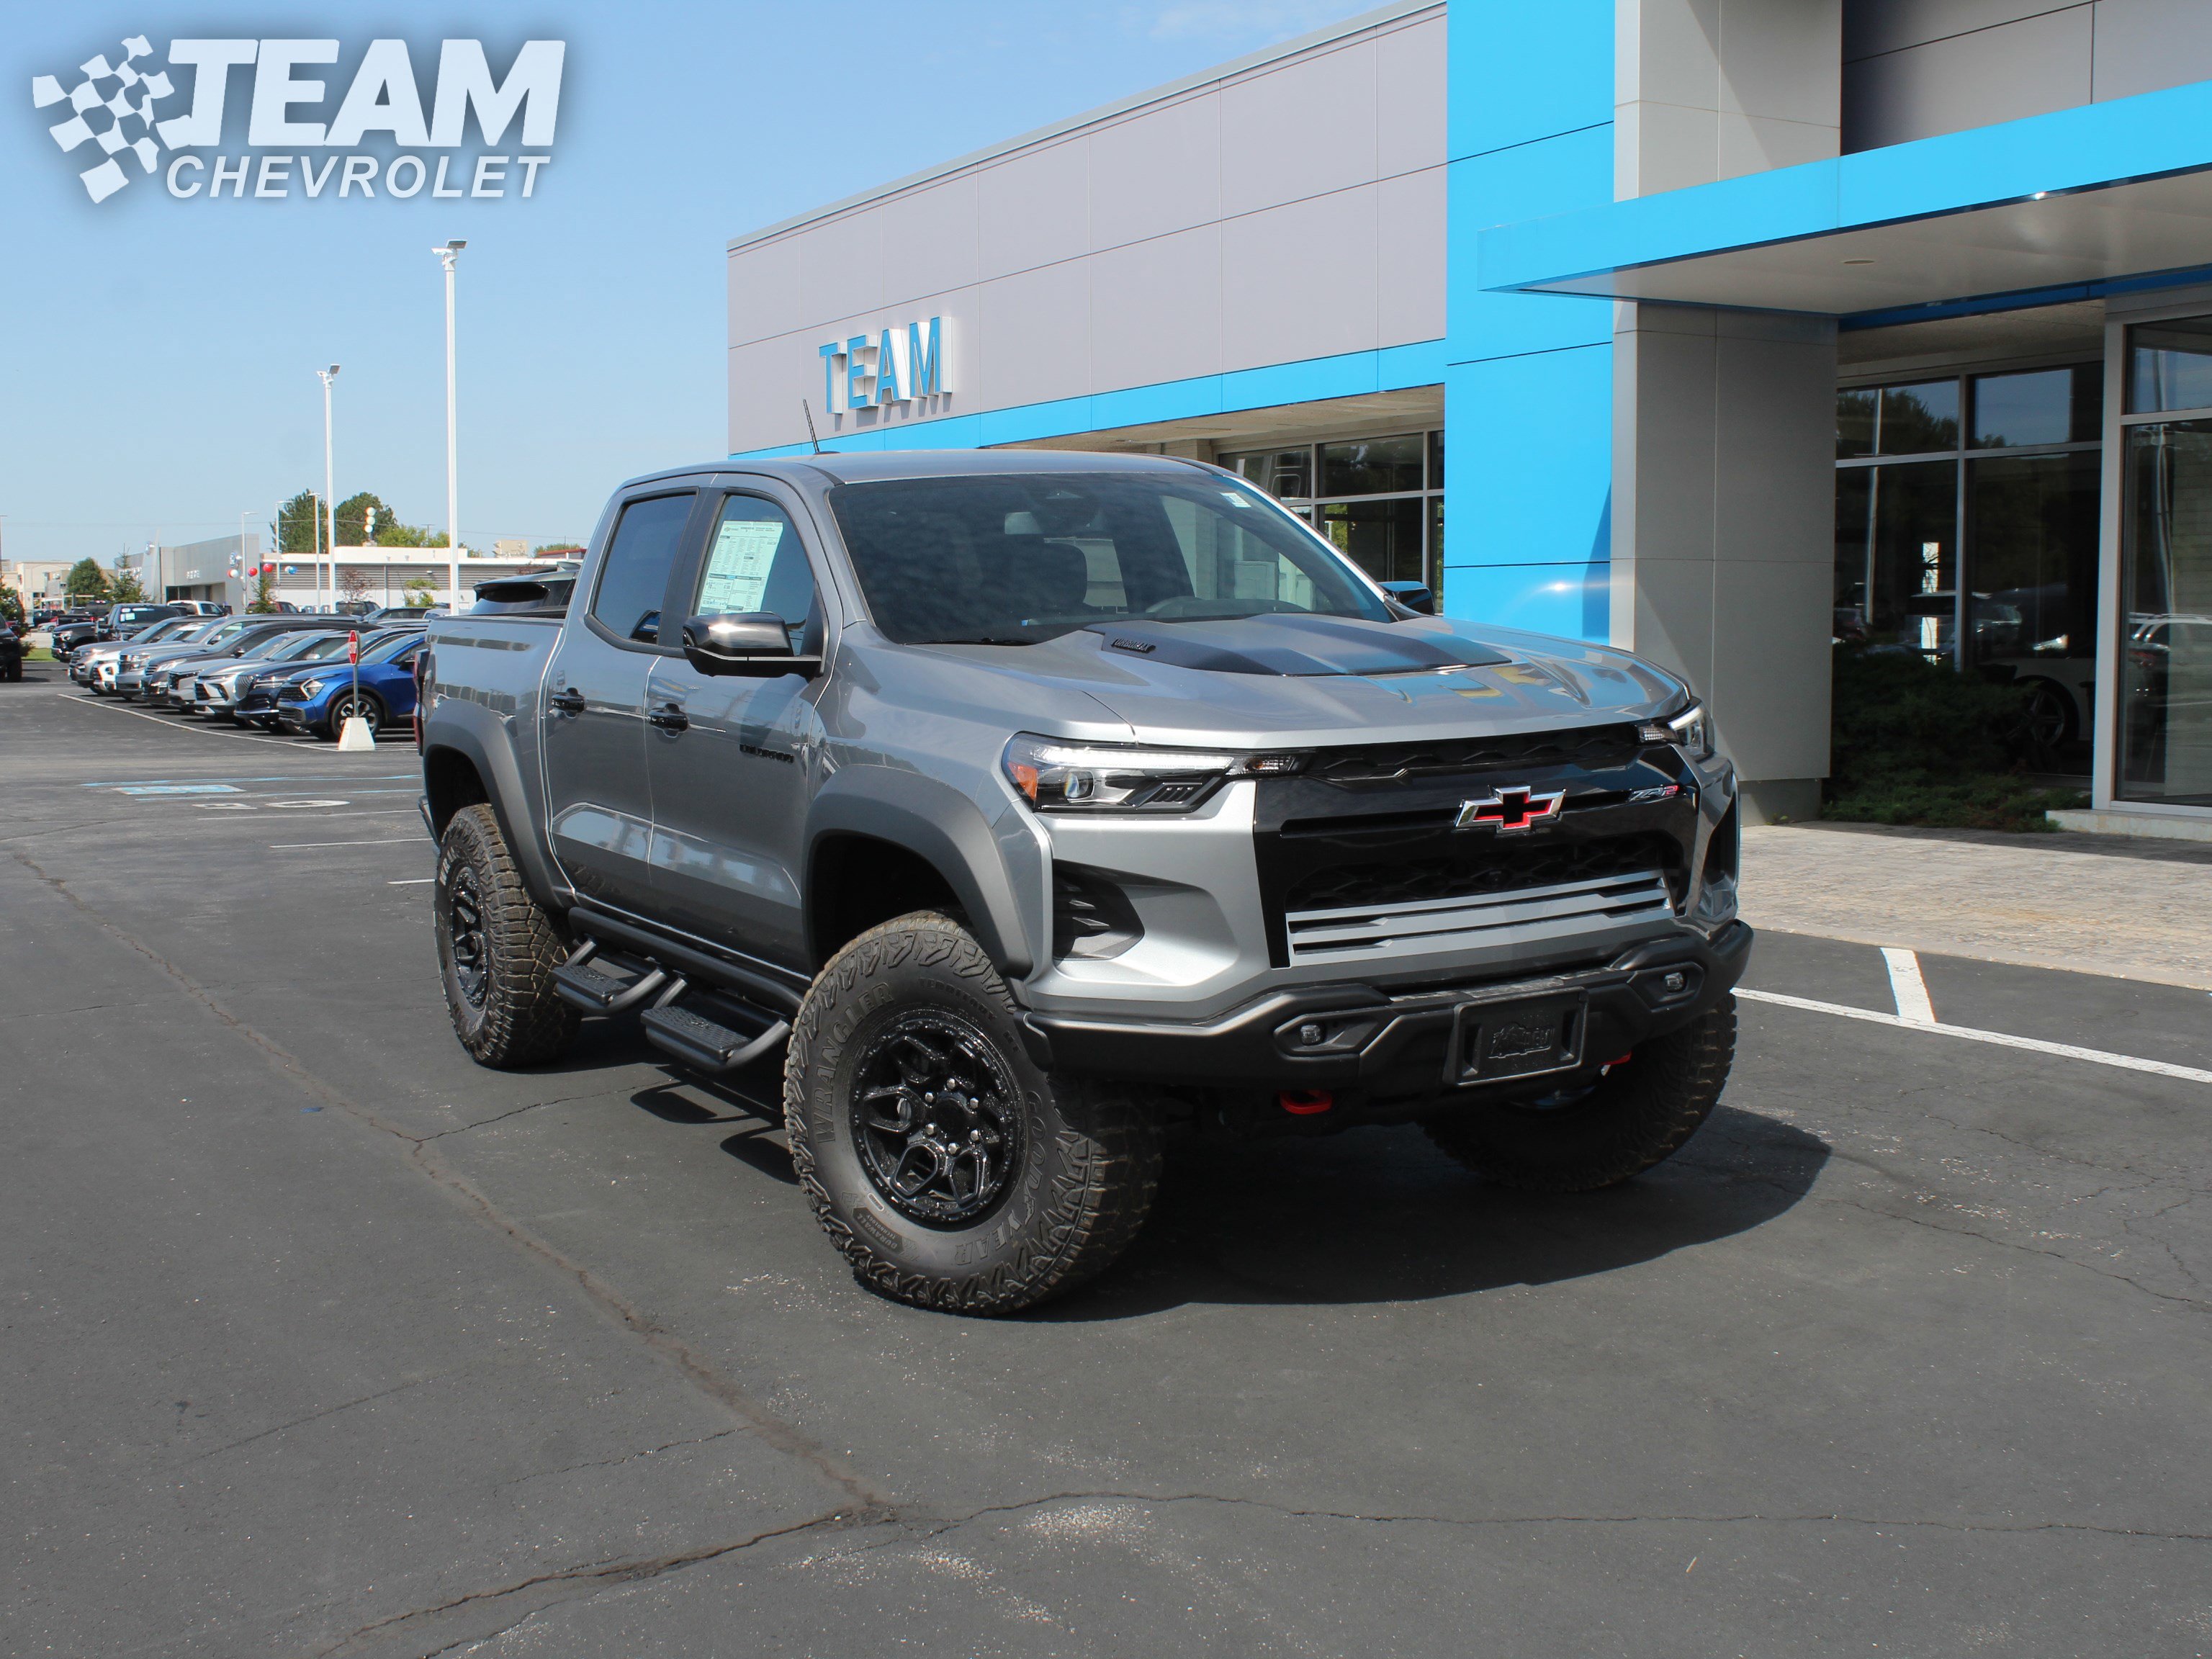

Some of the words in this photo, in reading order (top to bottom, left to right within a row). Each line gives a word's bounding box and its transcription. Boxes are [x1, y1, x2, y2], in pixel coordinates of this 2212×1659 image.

[819, 316, 953, 415] TEAM
[349, 640, 358, 655] STOP
[1629, 785, 1678, 802] ZR2
[917, 976, 997, 1021] TERRITORY
[812, 981, 894, 1143] WRANGLER
[856, 1213, 898, 1250] DURAWALL
[866, 1214, 896, 1240] TECHNOLOGY
